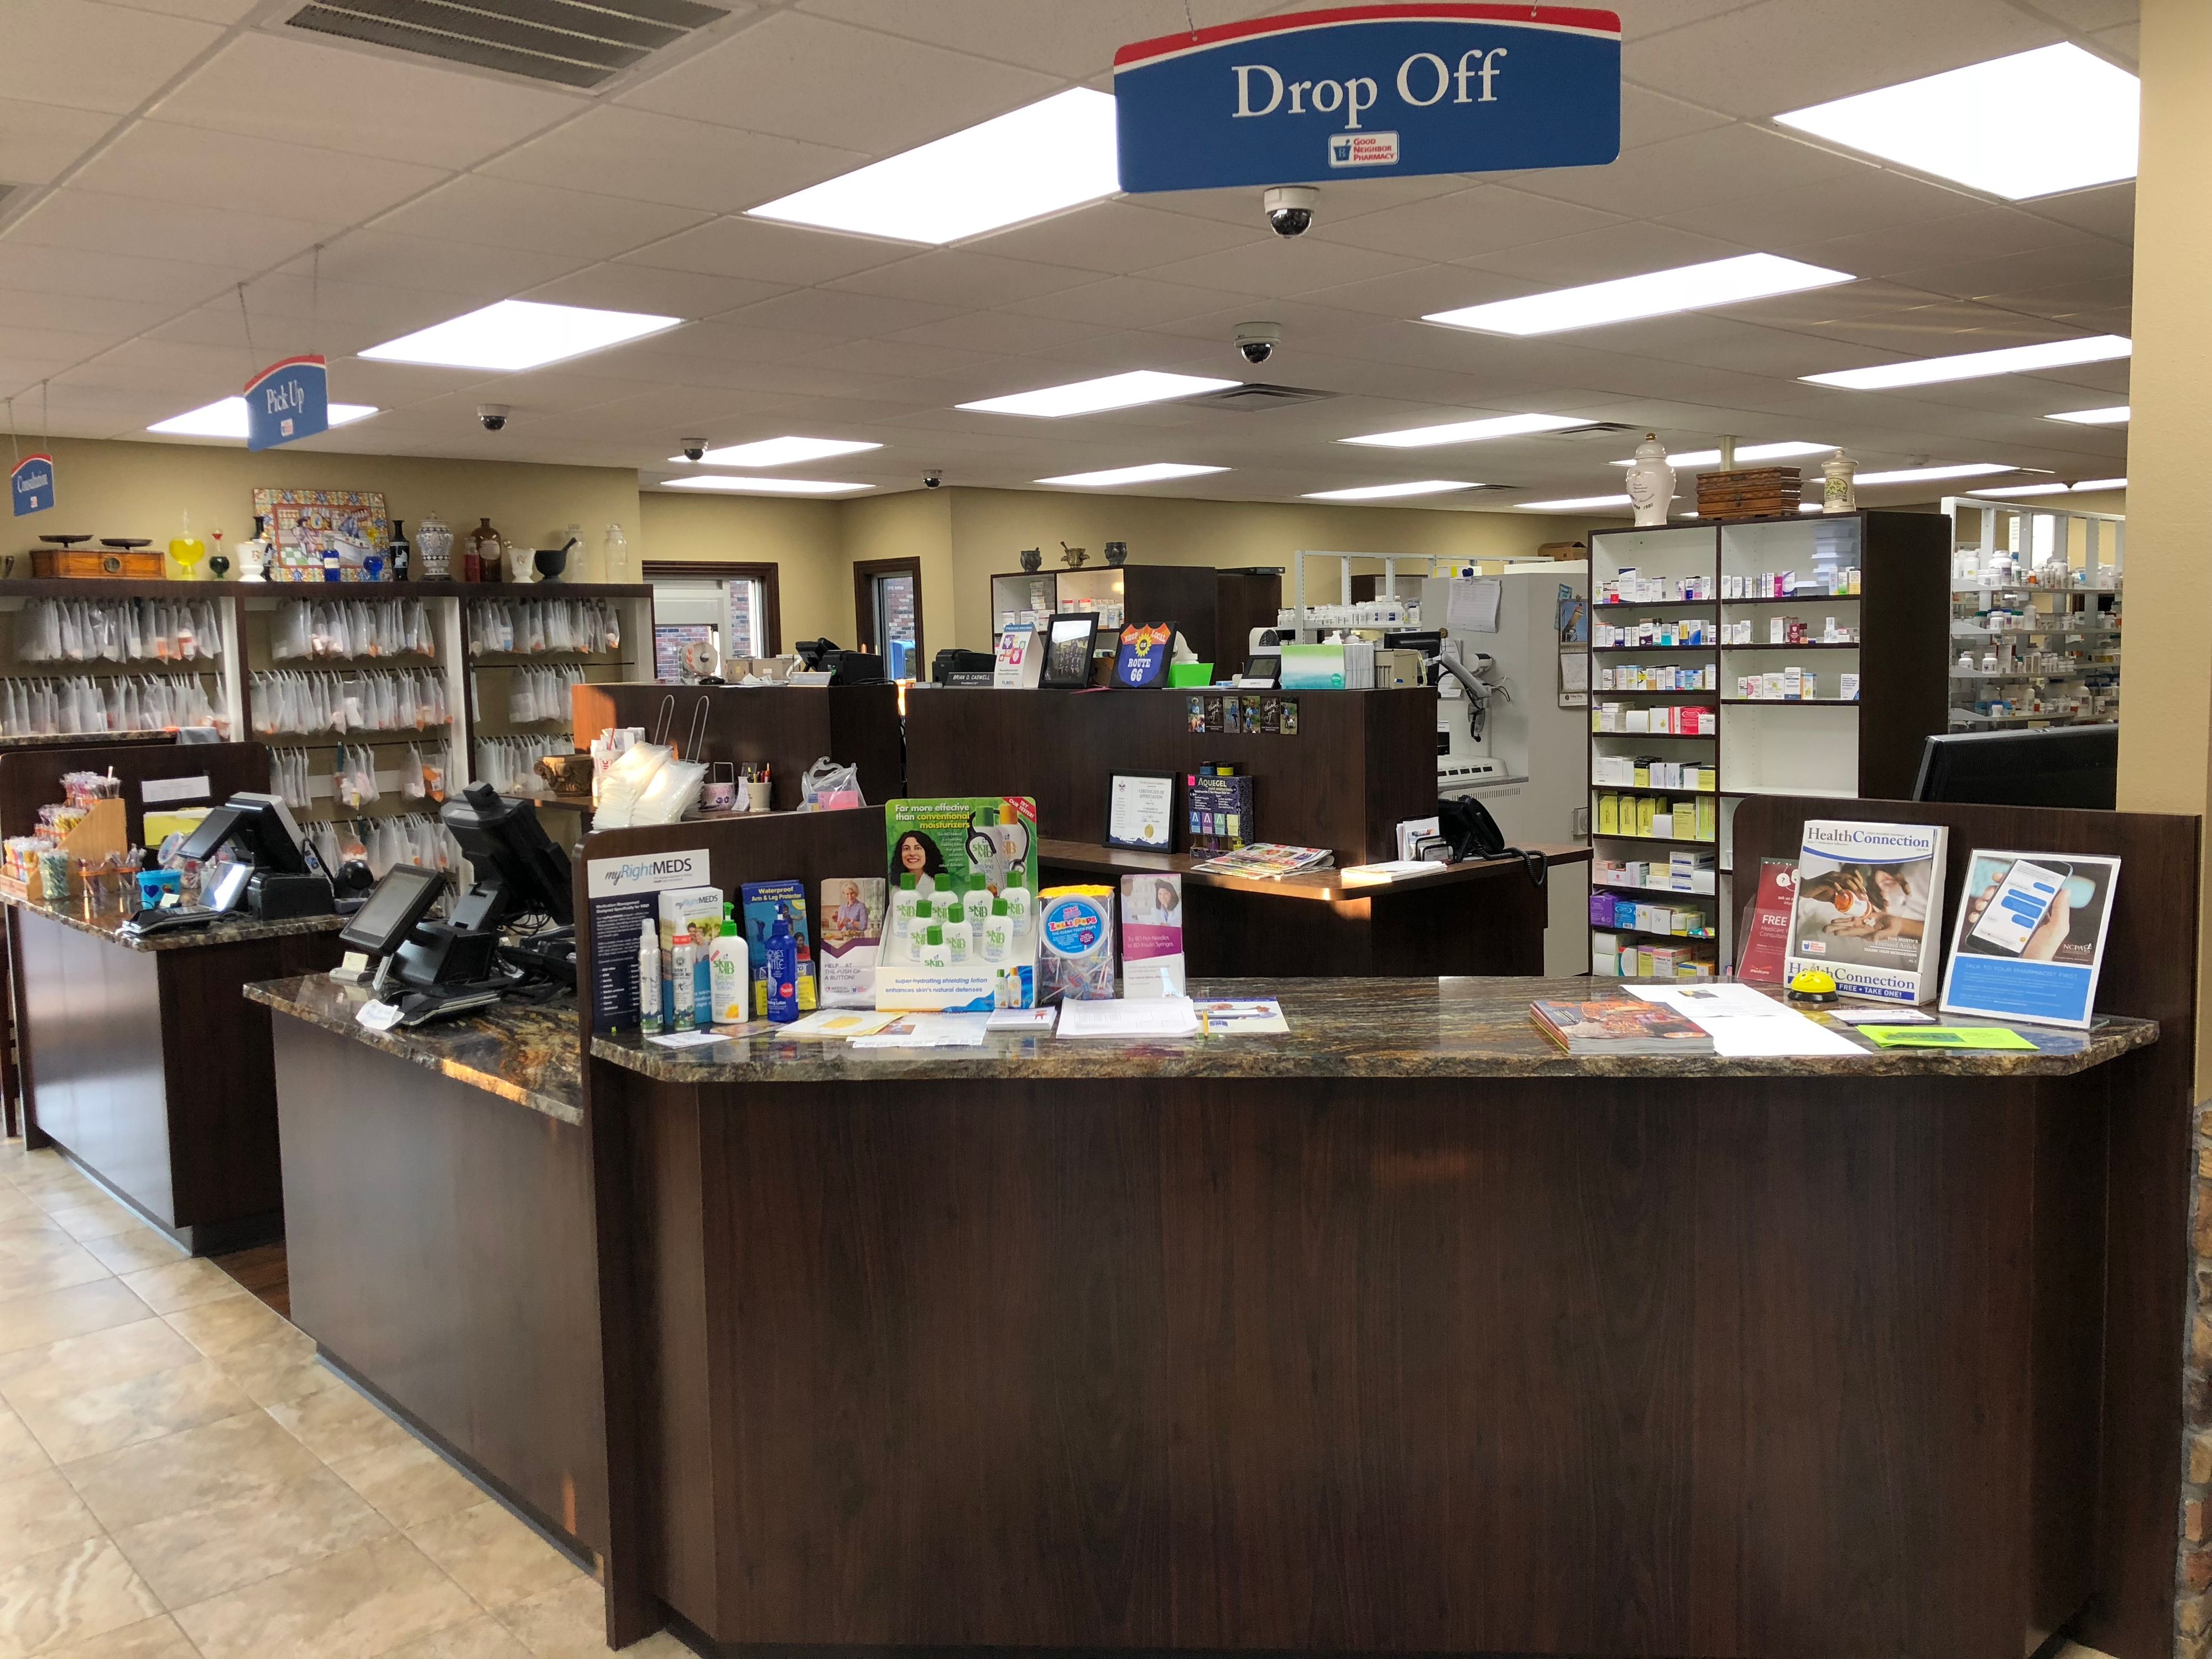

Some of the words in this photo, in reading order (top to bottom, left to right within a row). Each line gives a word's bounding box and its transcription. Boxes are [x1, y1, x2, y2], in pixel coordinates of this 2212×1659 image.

[1232, 64, 1378, 129] Drop
[1396, 48, 1508, 107] Off
[1353, 153, 1394, 161] PHARMACY
[266, 384, 289, 414] Pick
[288, 379, 304, 413] Up
[1124, 632, 1139, 643] SHOP
[1151, 630, 1166, 643] LOCAL
[1128, 658, 1151, 668] ROUTE
[1130, 668, 1143, 682] 66
[1198, 777, 1227, 787] AQUEGEL
[935, 802, 969, 811] effective
[1008, 799, 1019, 808] OUR
[1019, 805, 1034, 819] TESTER!
[1020, 800, 1029, 808] TRY
[895, 812, 915, 821] than
[916, 811, 970, 820] conventional
[920, 820, 970, 829] moisturizers
[1807, 827, 1929, 848] HealthConnection
[604, 858, 692, 886] myRightMEDS
[758, 886, 794, 894] Waterproof
[1762, 914, 1788, 926] FREE
[1875, 940, 1898, 948] Featured
[2013, 968, 2057, 977] PHARMACIST
[1839, 984, 1858, 992] FREE
[1865, 987, 1882, 995] TAKE
[1884, 990, 1902, 998] ONE!
